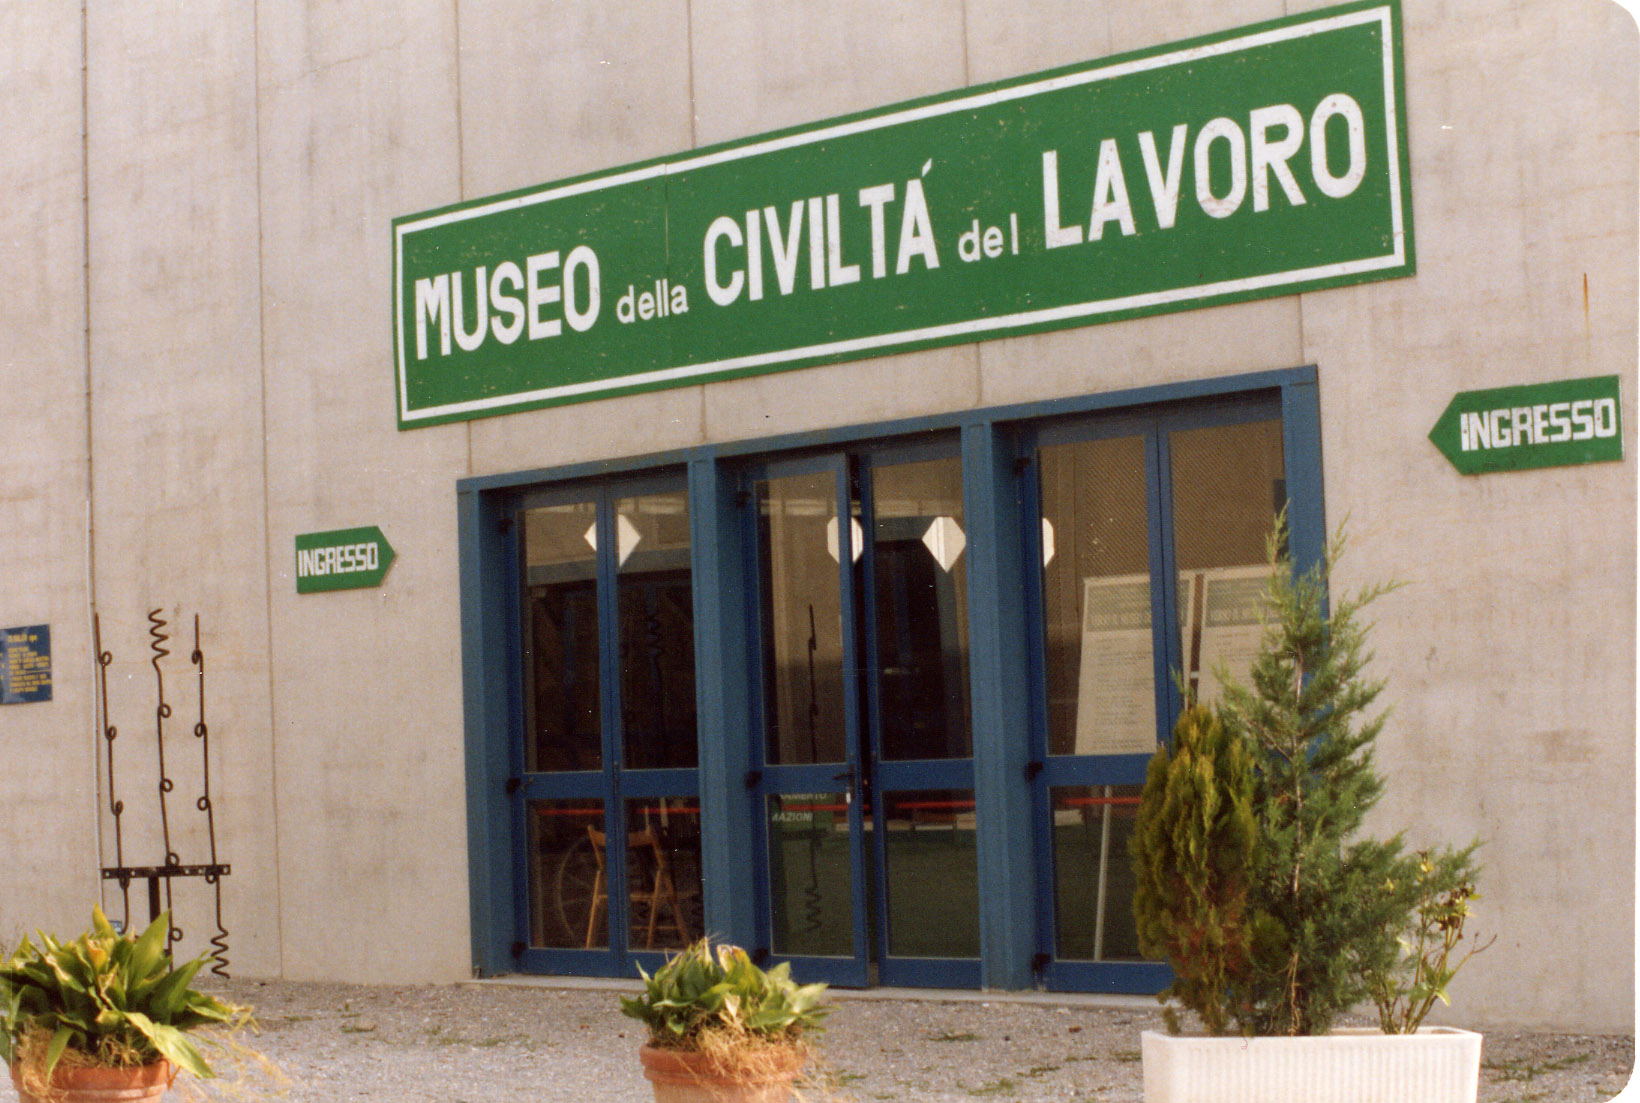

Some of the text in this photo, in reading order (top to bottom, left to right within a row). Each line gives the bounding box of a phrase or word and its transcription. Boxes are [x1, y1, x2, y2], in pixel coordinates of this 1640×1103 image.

[414, 92, 1366, 361] MUSEO della CIVILTÁ del LAVORO
[1460, 397, 1617, 452] INGRESSO
[297, 541, 379, 577] INGRESSO
